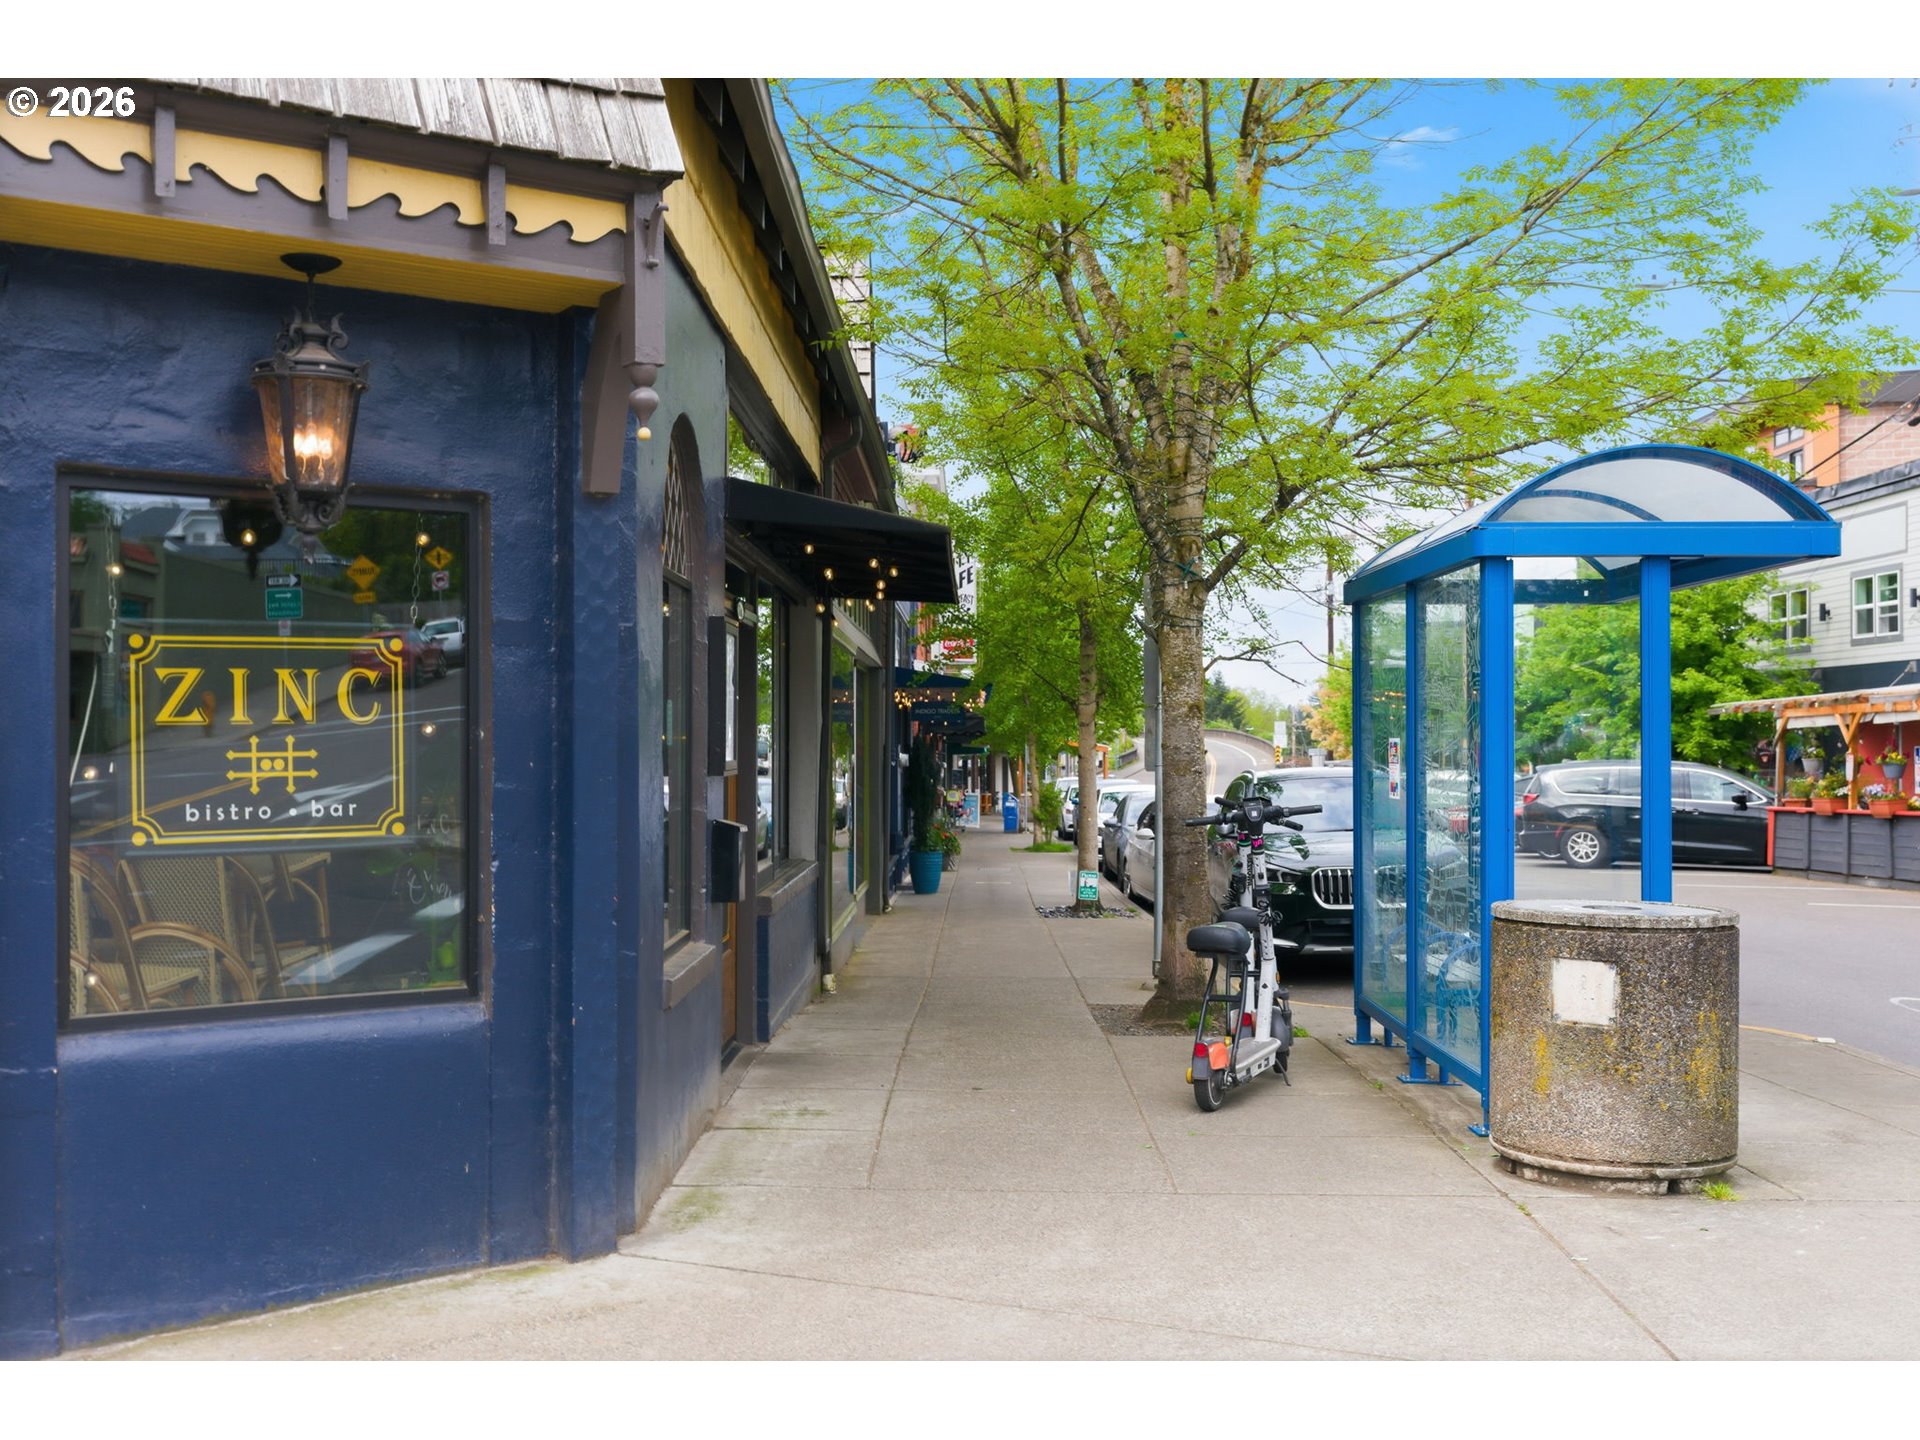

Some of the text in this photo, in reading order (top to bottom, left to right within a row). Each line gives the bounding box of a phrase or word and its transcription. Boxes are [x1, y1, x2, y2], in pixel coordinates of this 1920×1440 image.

[958, 565, 974, 589] FE
[154, 667, 382, 726] ZINC
[185, 800, 357, 822] bistro bar
